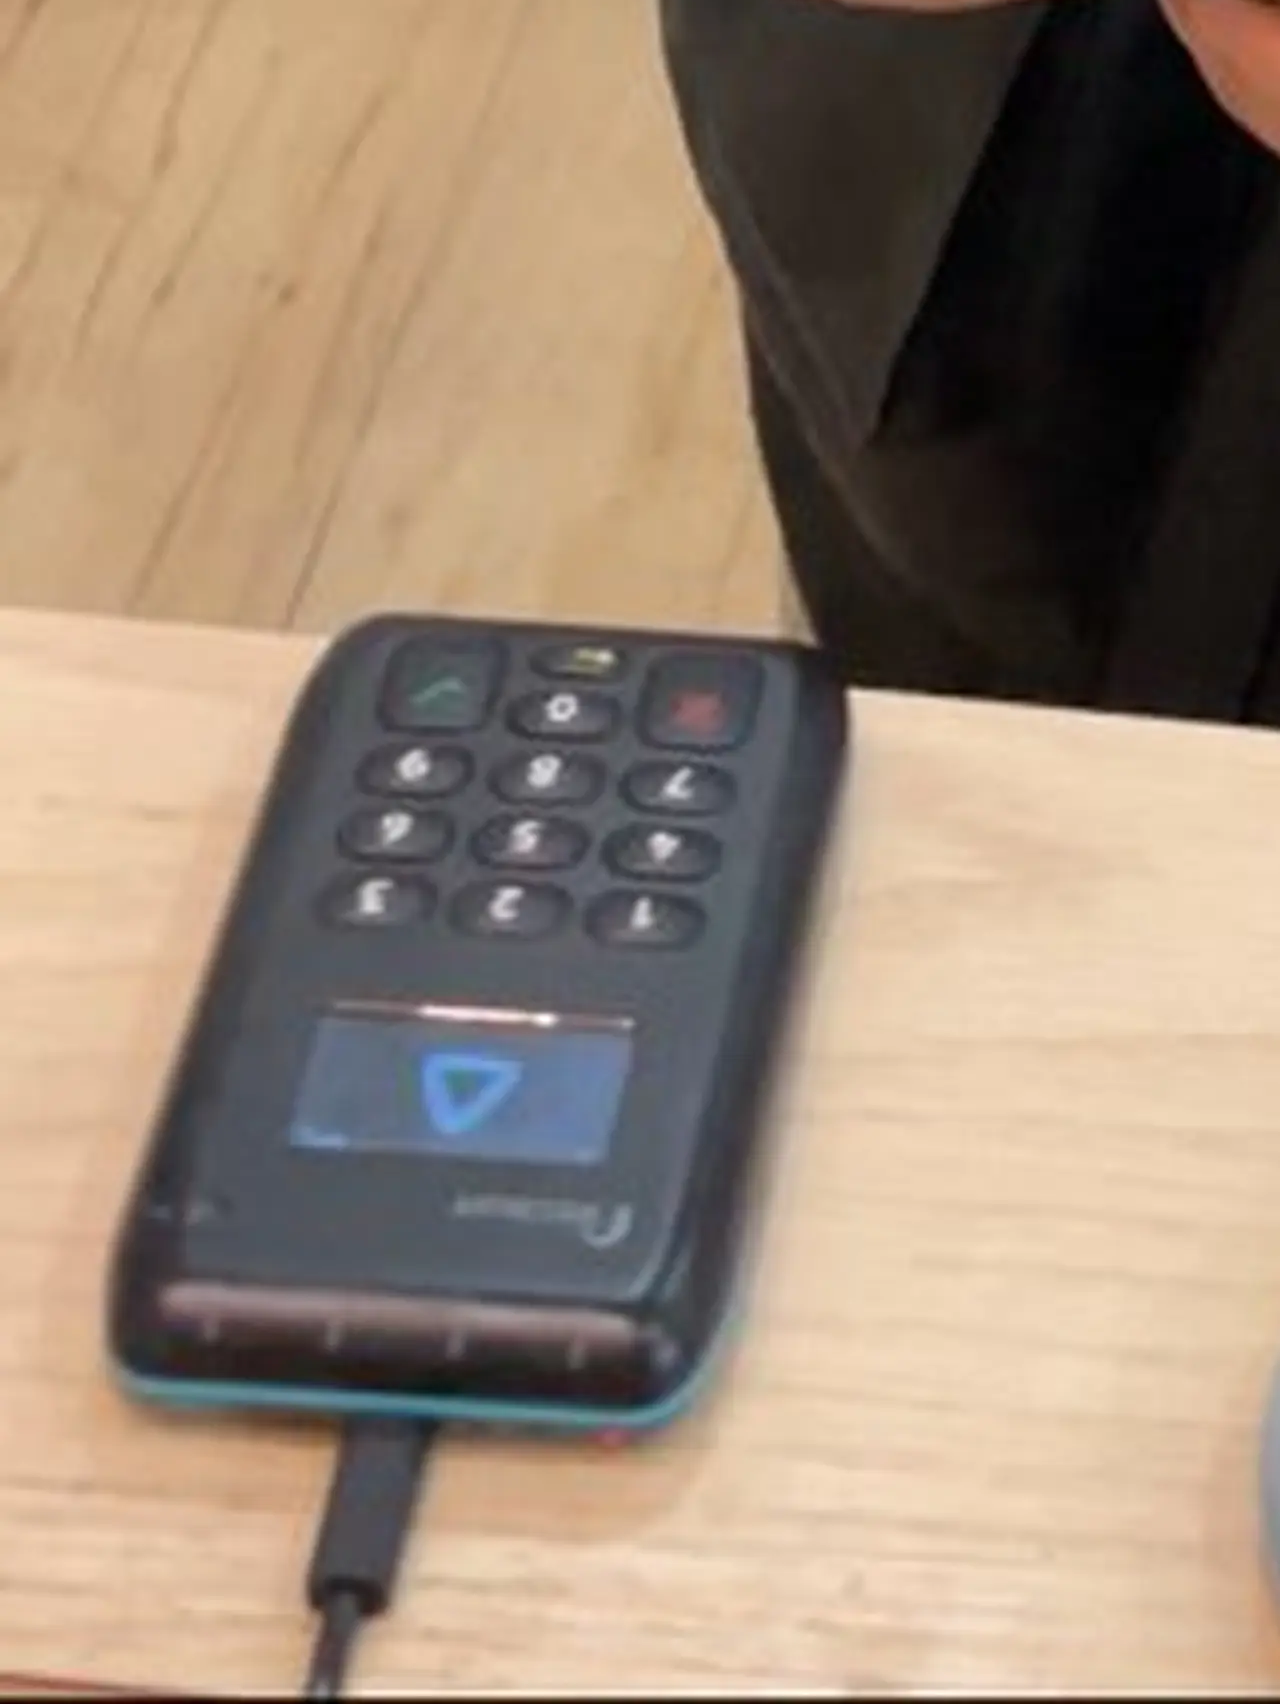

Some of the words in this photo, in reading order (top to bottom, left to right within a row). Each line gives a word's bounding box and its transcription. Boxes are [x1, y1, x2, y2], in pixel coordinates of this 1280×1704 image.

[545, 693, 579, 723] 0
[395, 746, 432, 783] 9
[526, 753, 563, 789] 8
[662, 765, 694, 801] 7
[379, 810, 414, 846] 6
[508, 819, 543, 854] 5
[647, 830, 682, 861] 4
[356, 877, 395, 916] 3
[488, 886, 525, 922] 2
[630, 896, 655, 931] 1
